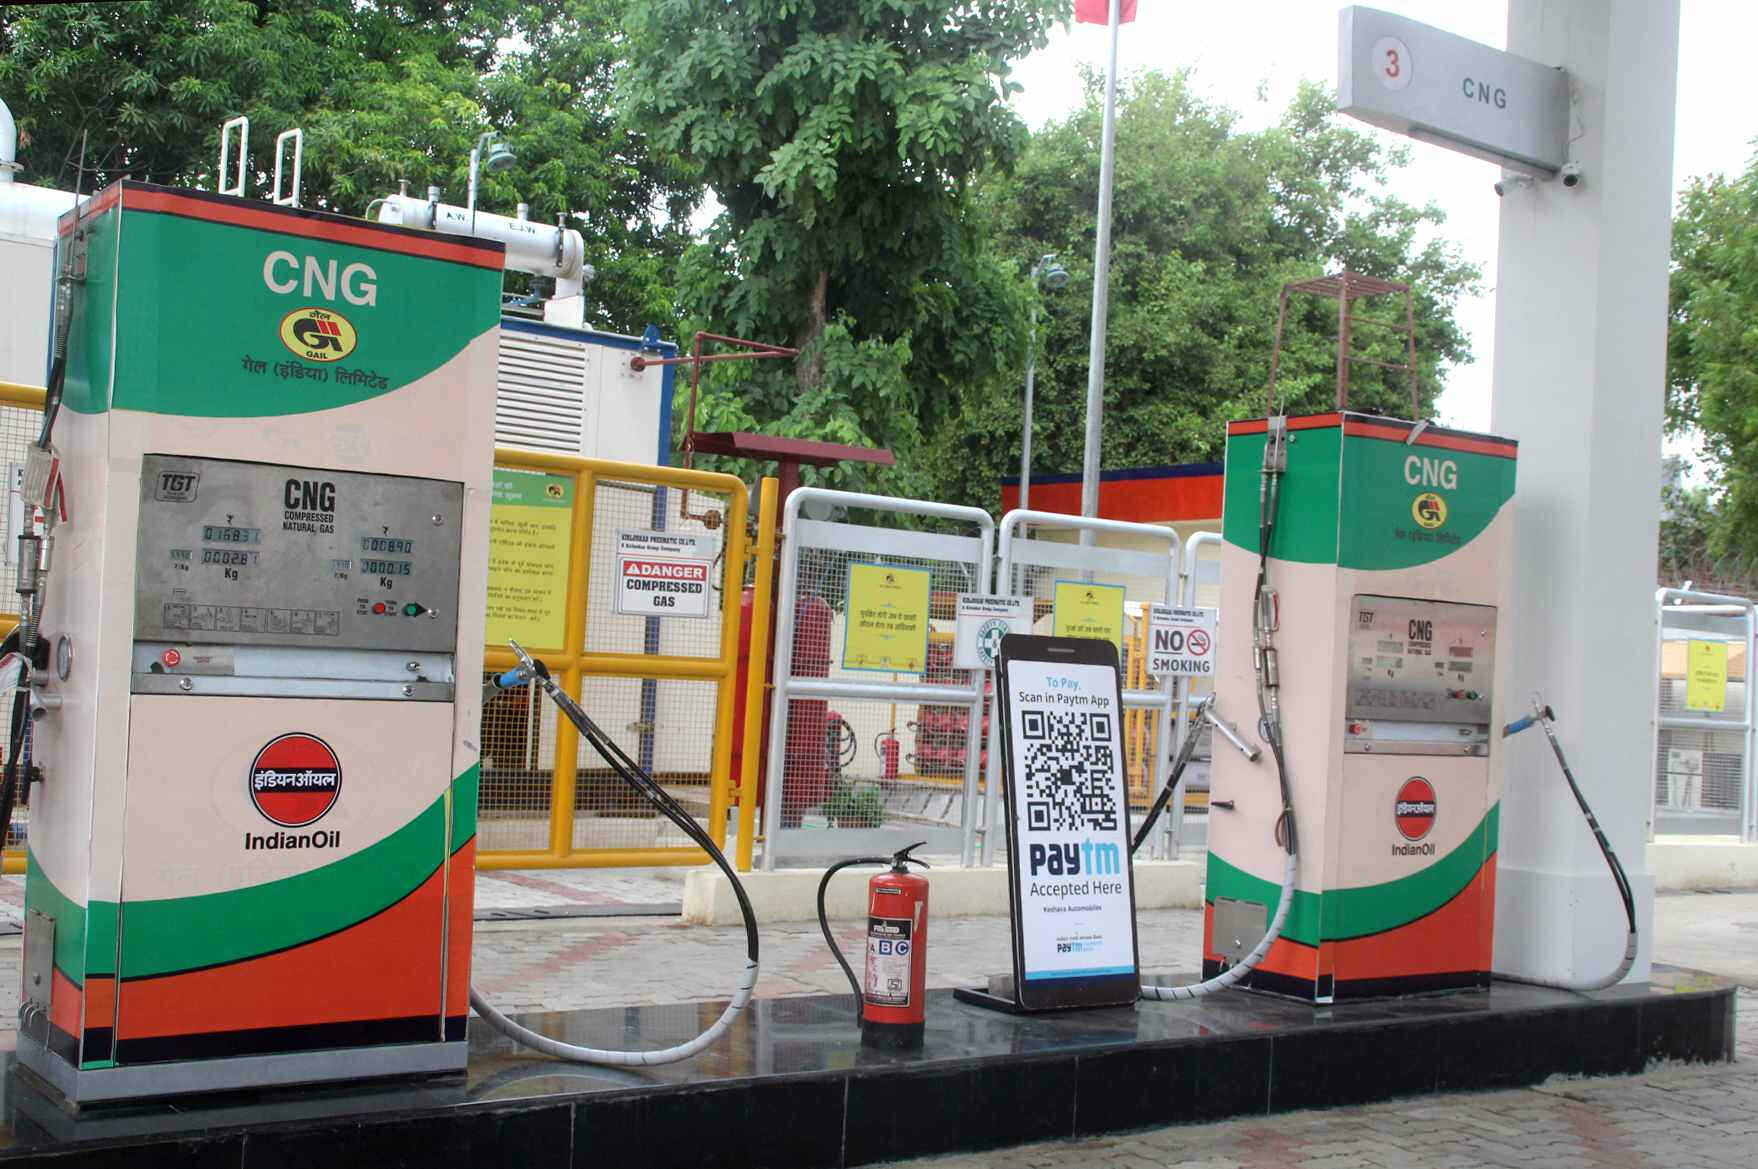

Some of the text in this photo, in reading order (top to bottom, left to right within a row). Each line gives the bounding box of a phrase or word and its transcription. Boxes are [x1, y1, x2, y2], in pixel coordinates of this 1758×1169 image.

[1386, 49, 1400, 78] 3
[1462, 78, 1506, 109] CNG
[263, 250, 377, 307] CNG
[306, 350, 328, 359] GAIL
[241, 354, 389, 389] गेल (इंडिया) लिमिटेड
[1404, 456, 1457, 490] CNG
[162, 474, 196, 492] TGT
[284, 479, 336, 512] CNG
[284, 511, 334, 523] COMPRESSED
[282, 523, 334, 534] NATURAL GAS
[224, 568, 238, 580] Kg
[641, 564, 704, 579] DANGER
[380, 577, 392, 590] Kg
[626, 579, 703, 594] COMPRESSED
[653, 596, 676, 607] GAS
[1408, 620, 1432, 641] CNG
[1155, 630, 1184, 651] NO
[1152, 658, 1210, 672] SMOKING
[1046, 676, 1058, 688] To
[1019, 692, 1110, 708] Scan in Paytm App
[254, 770, 337, 790] इंडियनऑयल
[245, 831, 340, 850] IndianOil
[1392, 843, 1436, 856] IndianOil
[1030, 881, 1122, 900] Accepted Here
[880, 941, 892, 955] B
[896, 942, 909, 955] C
